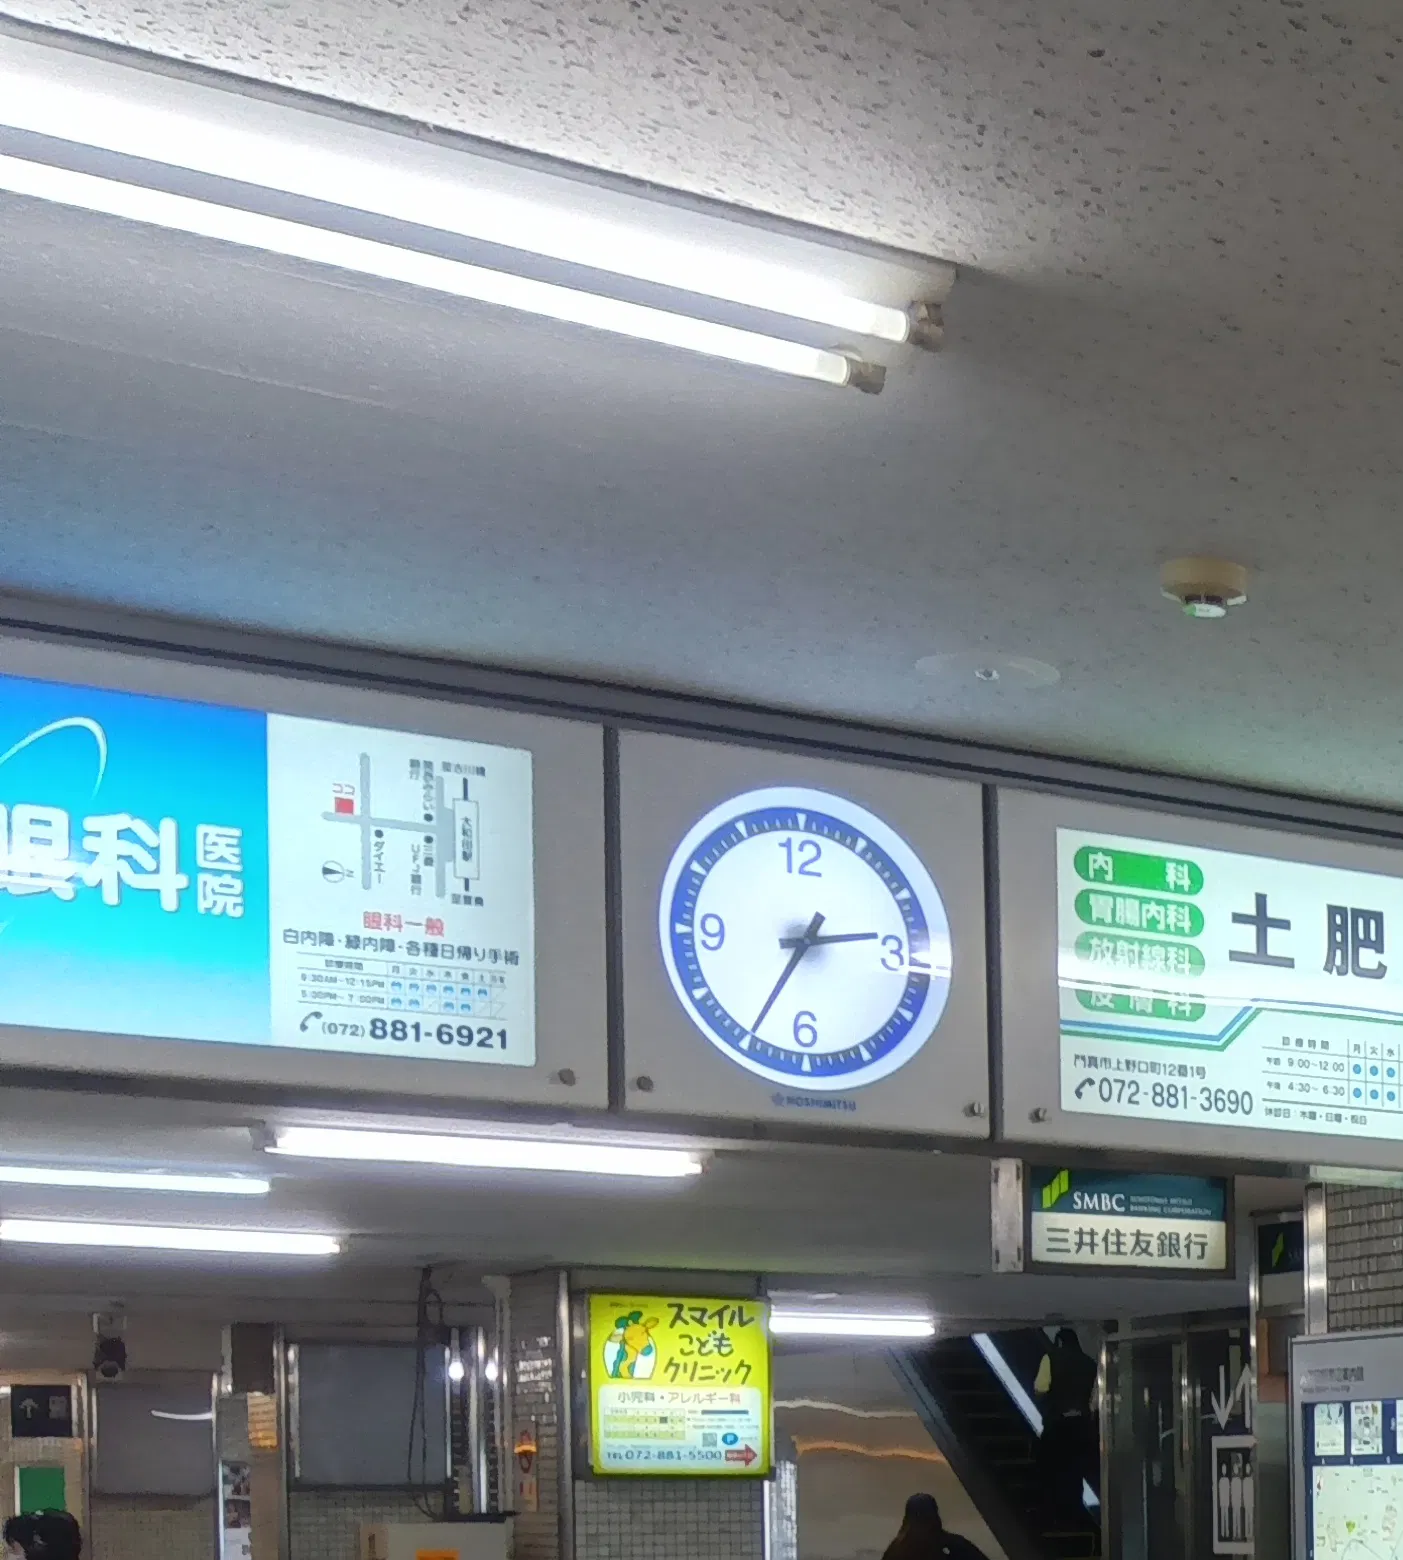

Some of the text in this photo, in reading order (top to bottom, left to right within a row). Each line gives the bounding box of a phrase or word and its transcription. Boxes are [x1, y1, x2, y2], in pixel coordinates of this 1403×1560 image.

[195, 823, 245, 918] 医院
[778, 837, 823, 878] 12
[362, 911, 445, 937] 眼科一般
[700, 913, 726, 951] 9
[1088, 893, 1192, 934] 胃腸内科
[879, 934, 905, 972] 3
[1088, 937, 1192, 976] 放射線科
[792, 1010, 818, 1048] 6
[1098, 1076, 1254, 1116] 072-881-3690
[1073, 1191, 1126, 1212] SMBC
[1046, 1226, 1209, 1261] 三井住友銀行
[666, 1302, 755, 1329] スマイル
[678, 1330, 734, 1358] こども
[663, 1356, 752, 1385] クリニック
[617, 1391, 741, 1405] 小児科・アレルギー科
